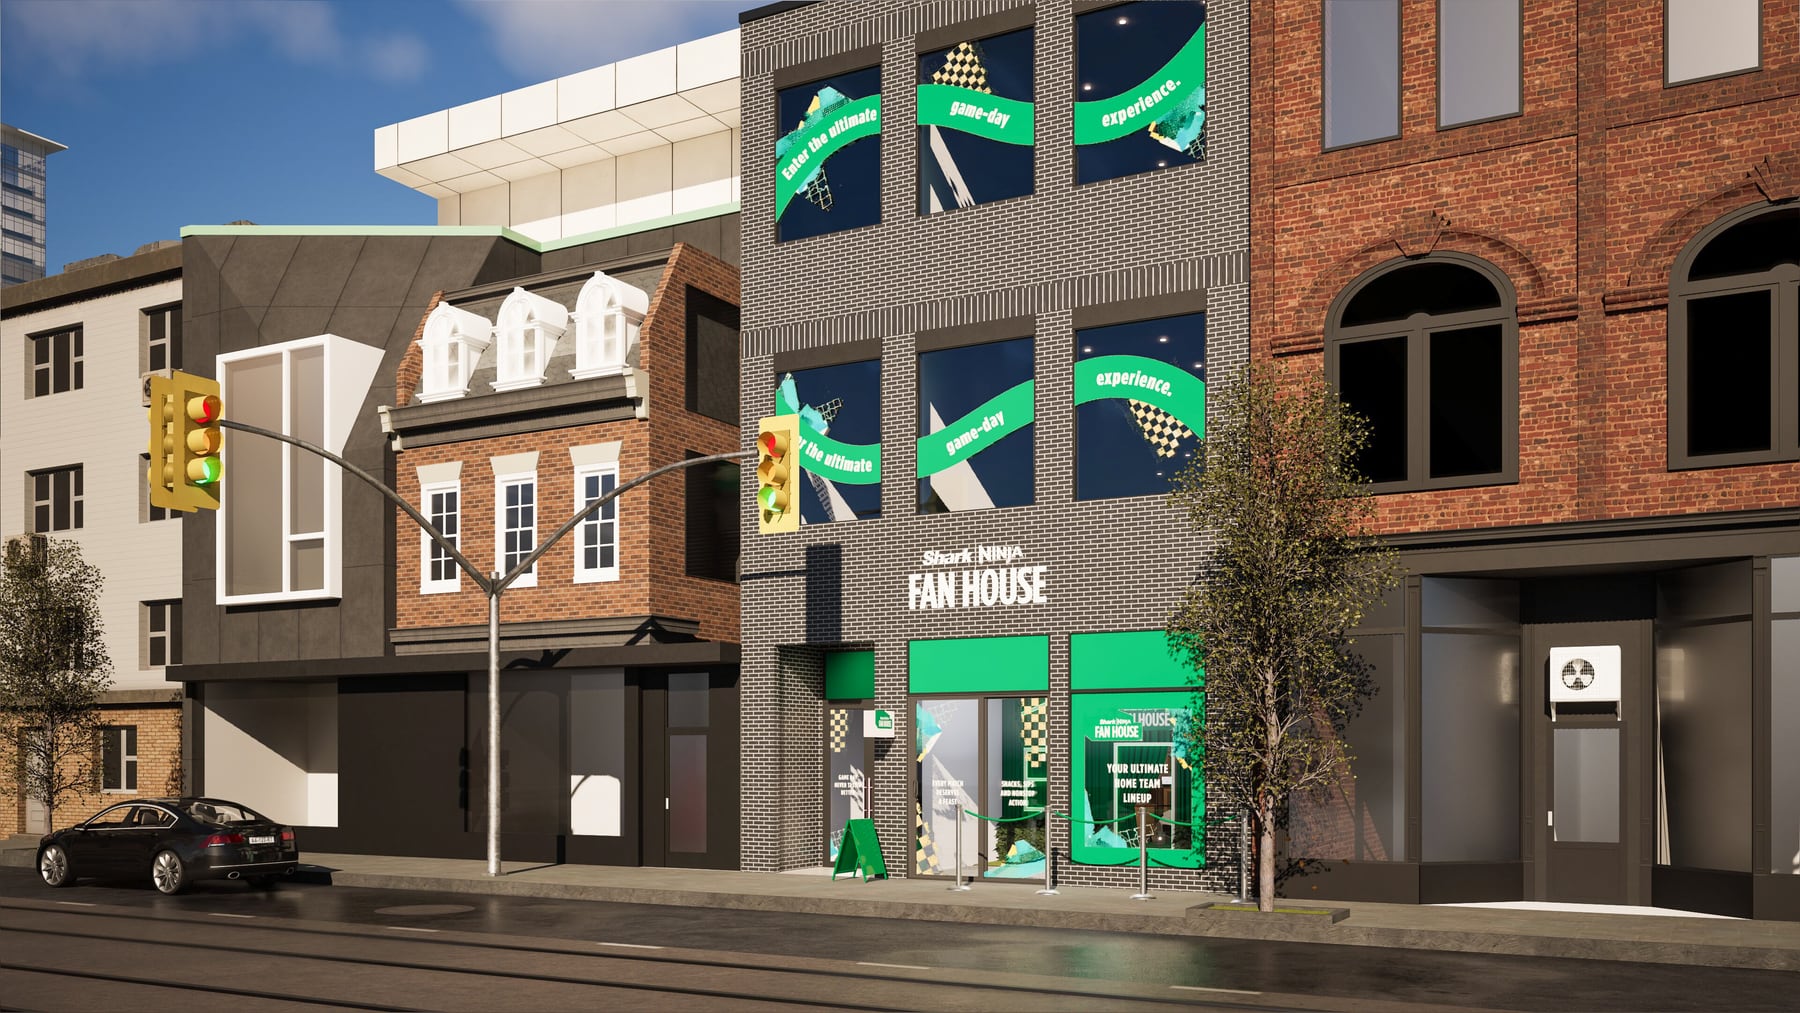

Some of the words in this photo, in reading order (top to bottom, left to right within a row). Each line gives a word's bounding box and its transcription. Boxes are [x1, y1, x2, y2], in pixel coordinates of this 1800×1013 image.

[949, 101, 1011, 129] game-day
[1102, 79, 1181, 127] experience.
[781, 149, 809, 181] Enter
[808, 133, 828, 153] the
[828, 108, 877, 138] ultimate
[1096, 370, 1172, 397] experience.
[946, 410, 1005, 456] game-day
[805, 441, 824, 462] the
[824, 453, 872, 473] ultimate
[922, 548, 973, 566] Shark
[908, 571, 955, 610] FAN
[962, 565, 1048, 607] HOUSE
[1094, 726, 1111, 738] FAN
[1112, 725, 1139, 738] HOUSE
[1107, 763, 1129, 774] YOUR
[1130, 763, 1169, 774] ULTIMATE
[1114, 778, 1137, 788] HOME
[1139, 778, 1161, 788] TEAM
[1123, 793, 1152, 804] LINEUP
